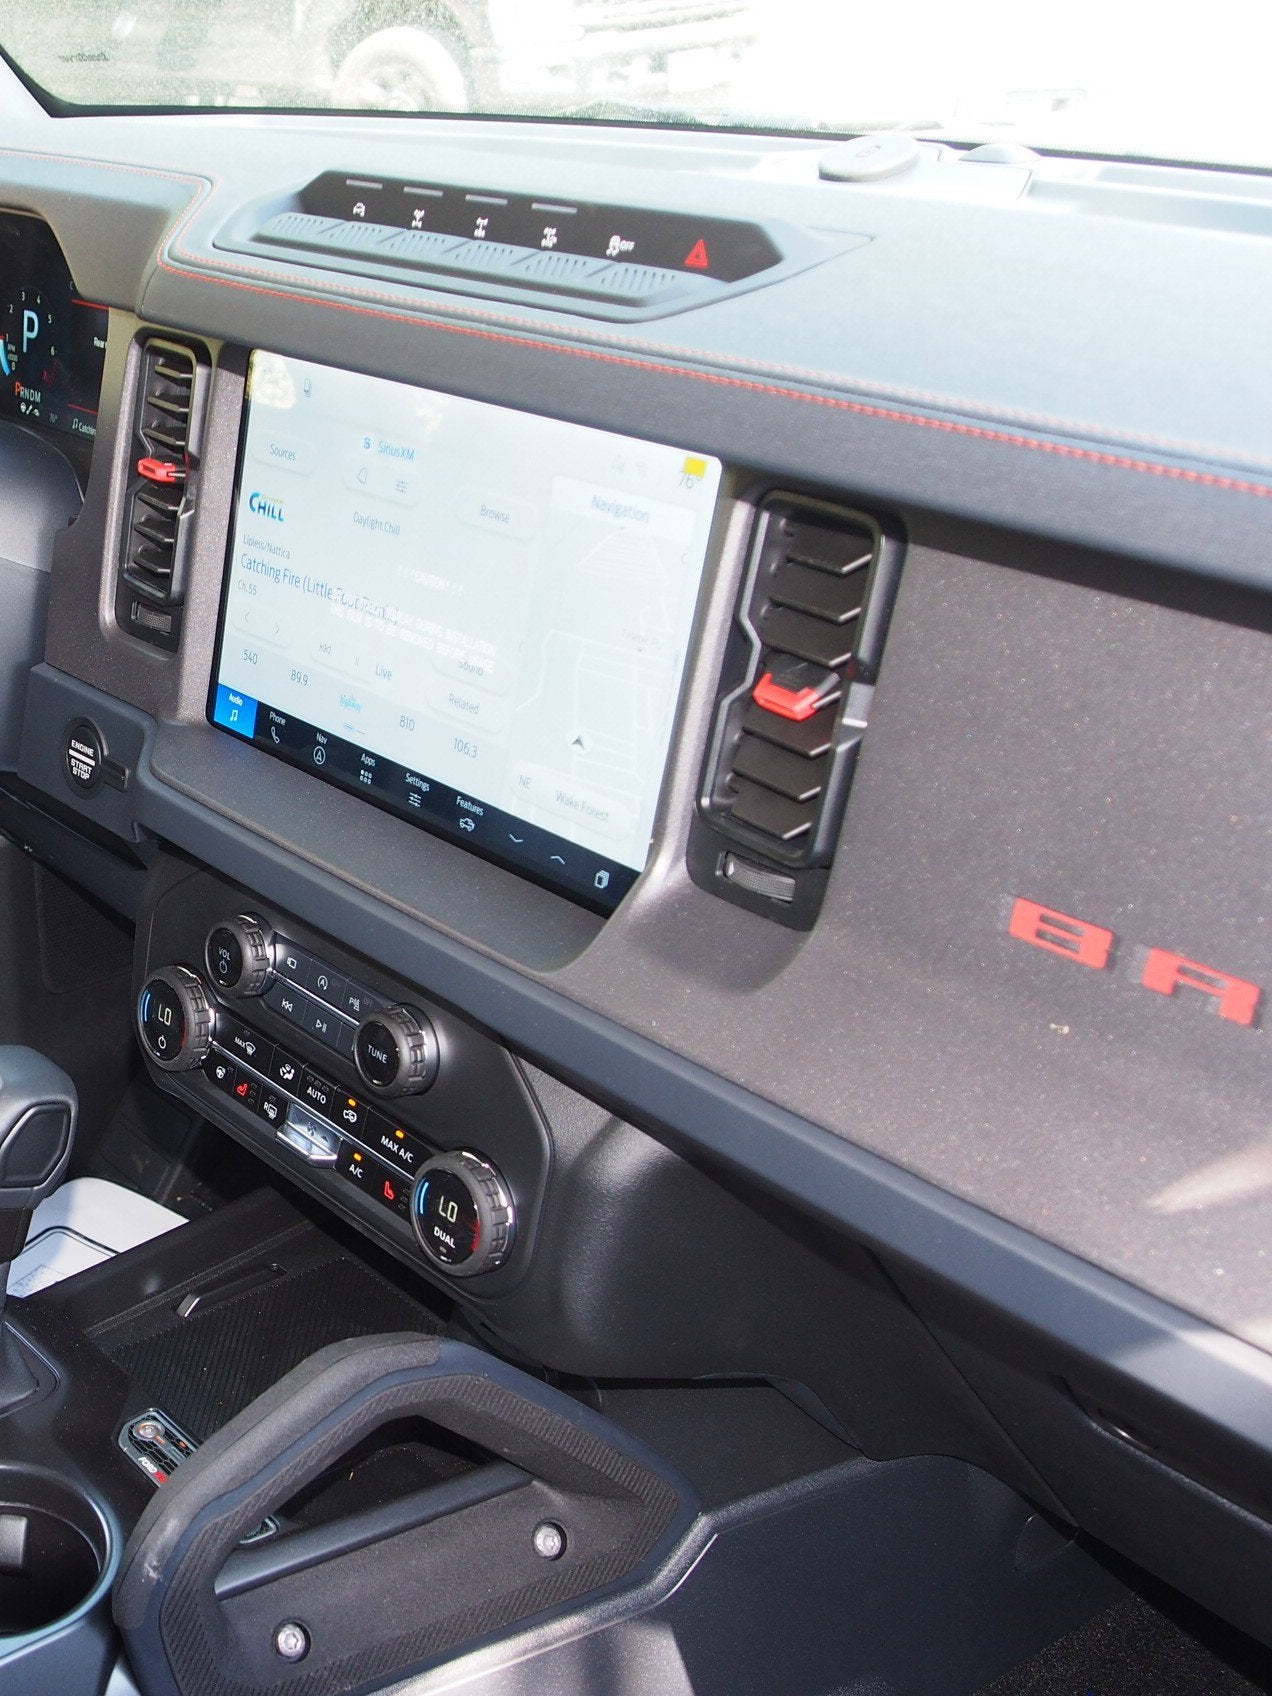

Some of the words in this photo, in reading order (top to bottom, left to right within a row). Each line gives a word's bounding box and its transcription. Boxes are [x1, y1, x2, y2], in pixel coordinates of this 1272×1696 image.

[23, 309, 39, 353] P
[270, 443, 296, 462] Sources
[378, 440, 415, 462] SiriusXM
[480, 504, 511, 524] Browse
[591, 494, 650, 524] Navigation
[353, 511, 383, 531] Daylight
[384, 520, 401, 536] Chill
[240, 553, 281, 584] Catching
[282, 568, 301, 588] Fire
[302, 575, 333, 600] (Little
[242, 648, 258, 665] 540
[290, 668, 309, 686] 89.9
[375, 663, 393, 680] Live
[228, 692, 244, 707] Audio
[448, 692, 479, 715] Related
[269, 710, 287, 726] Phone
[399, 715, 415, 732] 810
[316, 732, 328, 745] Nav
[453, 736, 478, 759] 106.3
[71, 739, 95, 758] ENGINE
[70, 757, 93, 775] START
[360, 752, 376, 768] Apps
[72, 766, 90, 780] STOP
[405, 772, 430, 792] Settings
[456, 795, 484, 816] Features
[556, 789, 580, 811] Wake
[580, 800, 610, 824] Forest
[218, 946, 231, 961] VOL
[234, 1036, 247, 1048] MAX
[367, 1043, 389, 1065] TUNE
[306, 1085, 328, 1105] AUTO
[380, 1134, 399, 1154] MAX
[397, 1145, 415, 1163] A/C
[348, 1163, 364, 1179] A/C
[433, 1225, 456, 1249] DUAL
